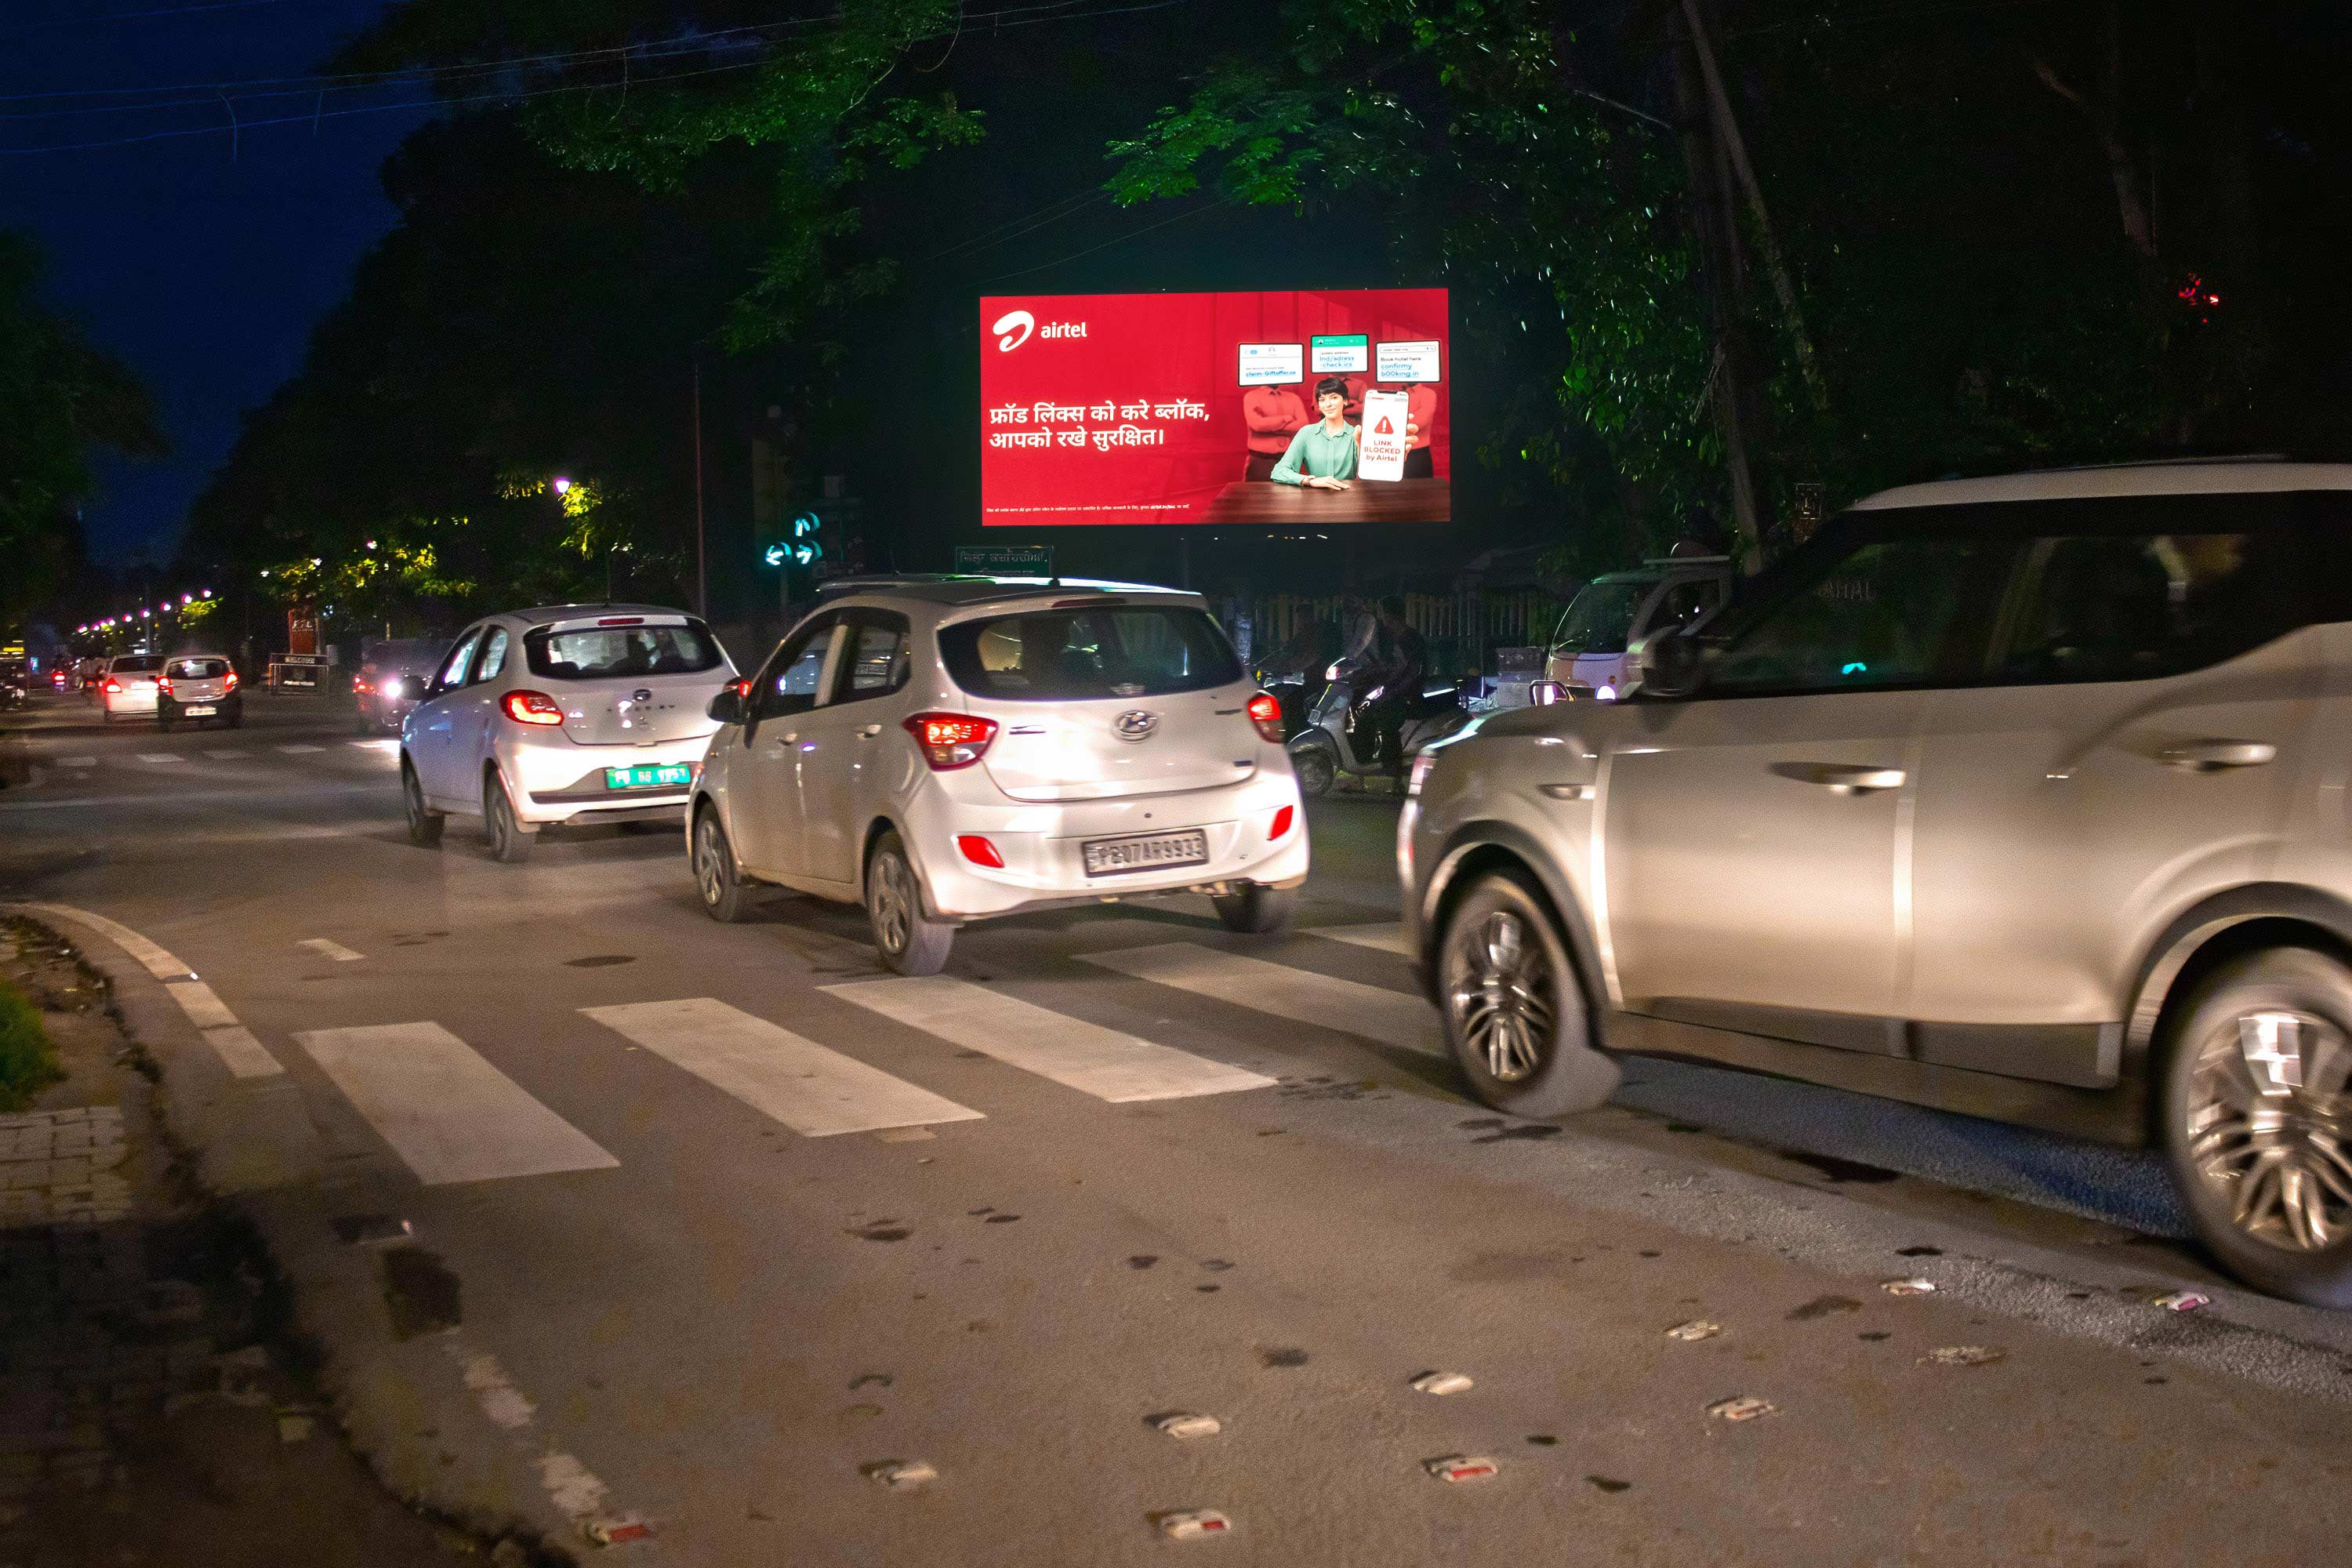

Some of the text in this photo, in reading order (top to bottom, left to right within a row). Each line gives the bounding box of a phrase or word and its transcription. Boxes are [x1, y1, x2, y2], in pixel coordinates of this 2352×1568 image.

[1040, 321, 1087, 339] airtel
[989, 398, 1210, 425] फ्रॉड लिंक्स को करे ब्लॉक,
[989, 424, 1164, 452] आपको रखे सुरक्षित।
[1363, 446, 1401, 455] BLOCKED
